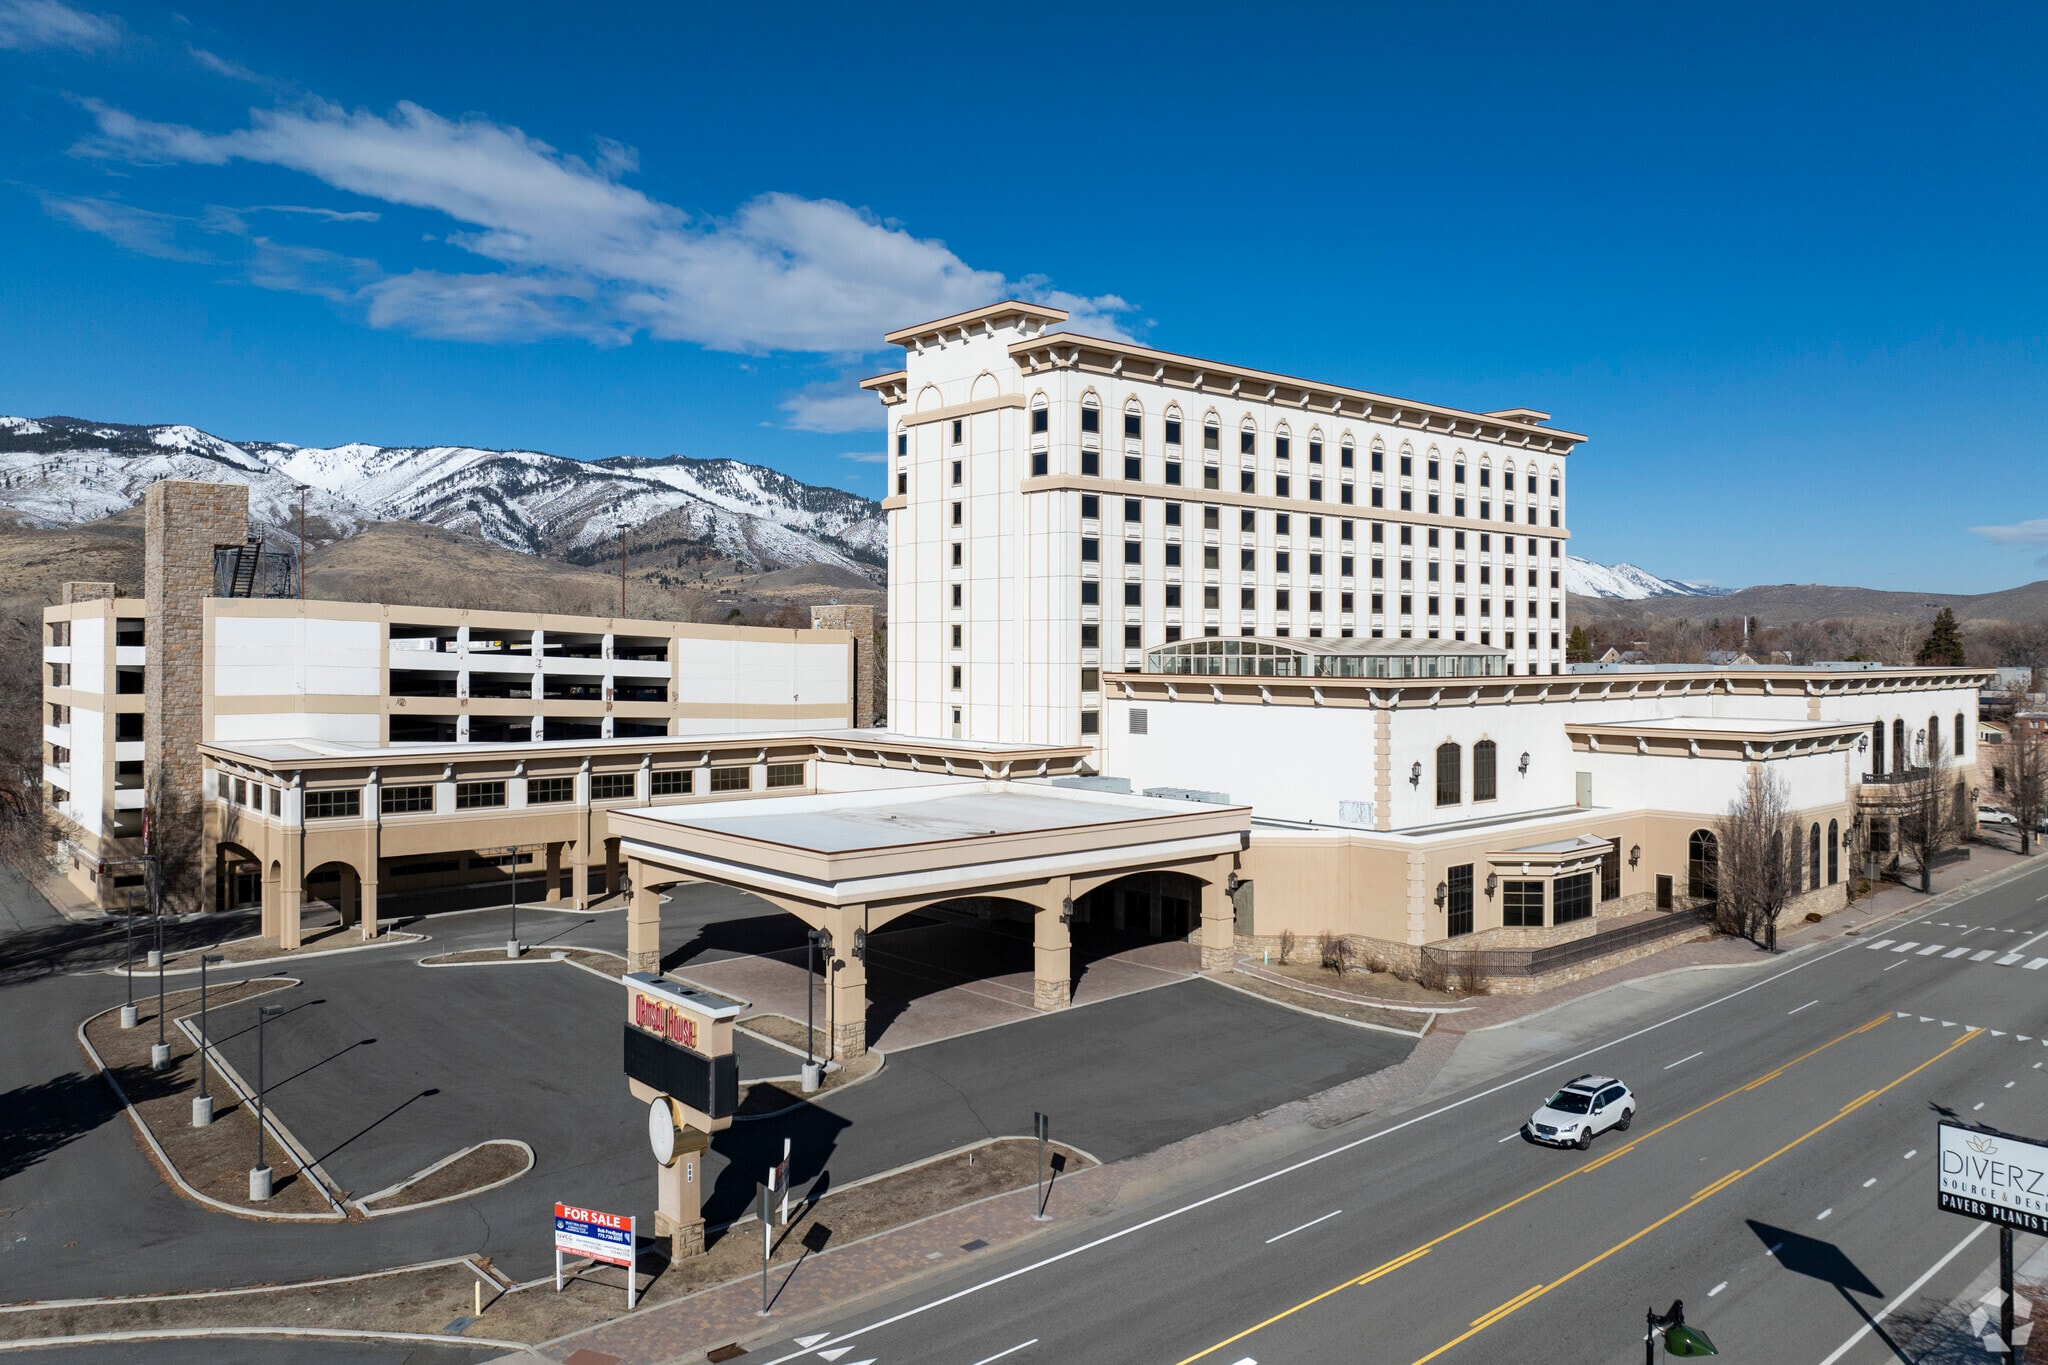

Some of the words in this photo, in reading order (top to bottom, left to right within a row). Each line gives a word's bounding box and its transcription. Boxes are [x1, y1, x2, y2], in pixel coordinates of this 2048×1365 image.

[668, 1006, 695, 1048] House
[1943, 1150, 2048, 1197] DIVERZ
[1943, 1178, 1996, 1199] SOURCE
[2001, 1192, 2008, 1202] &
[564, 1207, 588, 1221] FOR
[591, 1212, 620, 1227] SALE
[1942, 1194, 1986, 1216] PAVERS
[1992, 1207, 2038, 1229] PLANTS
